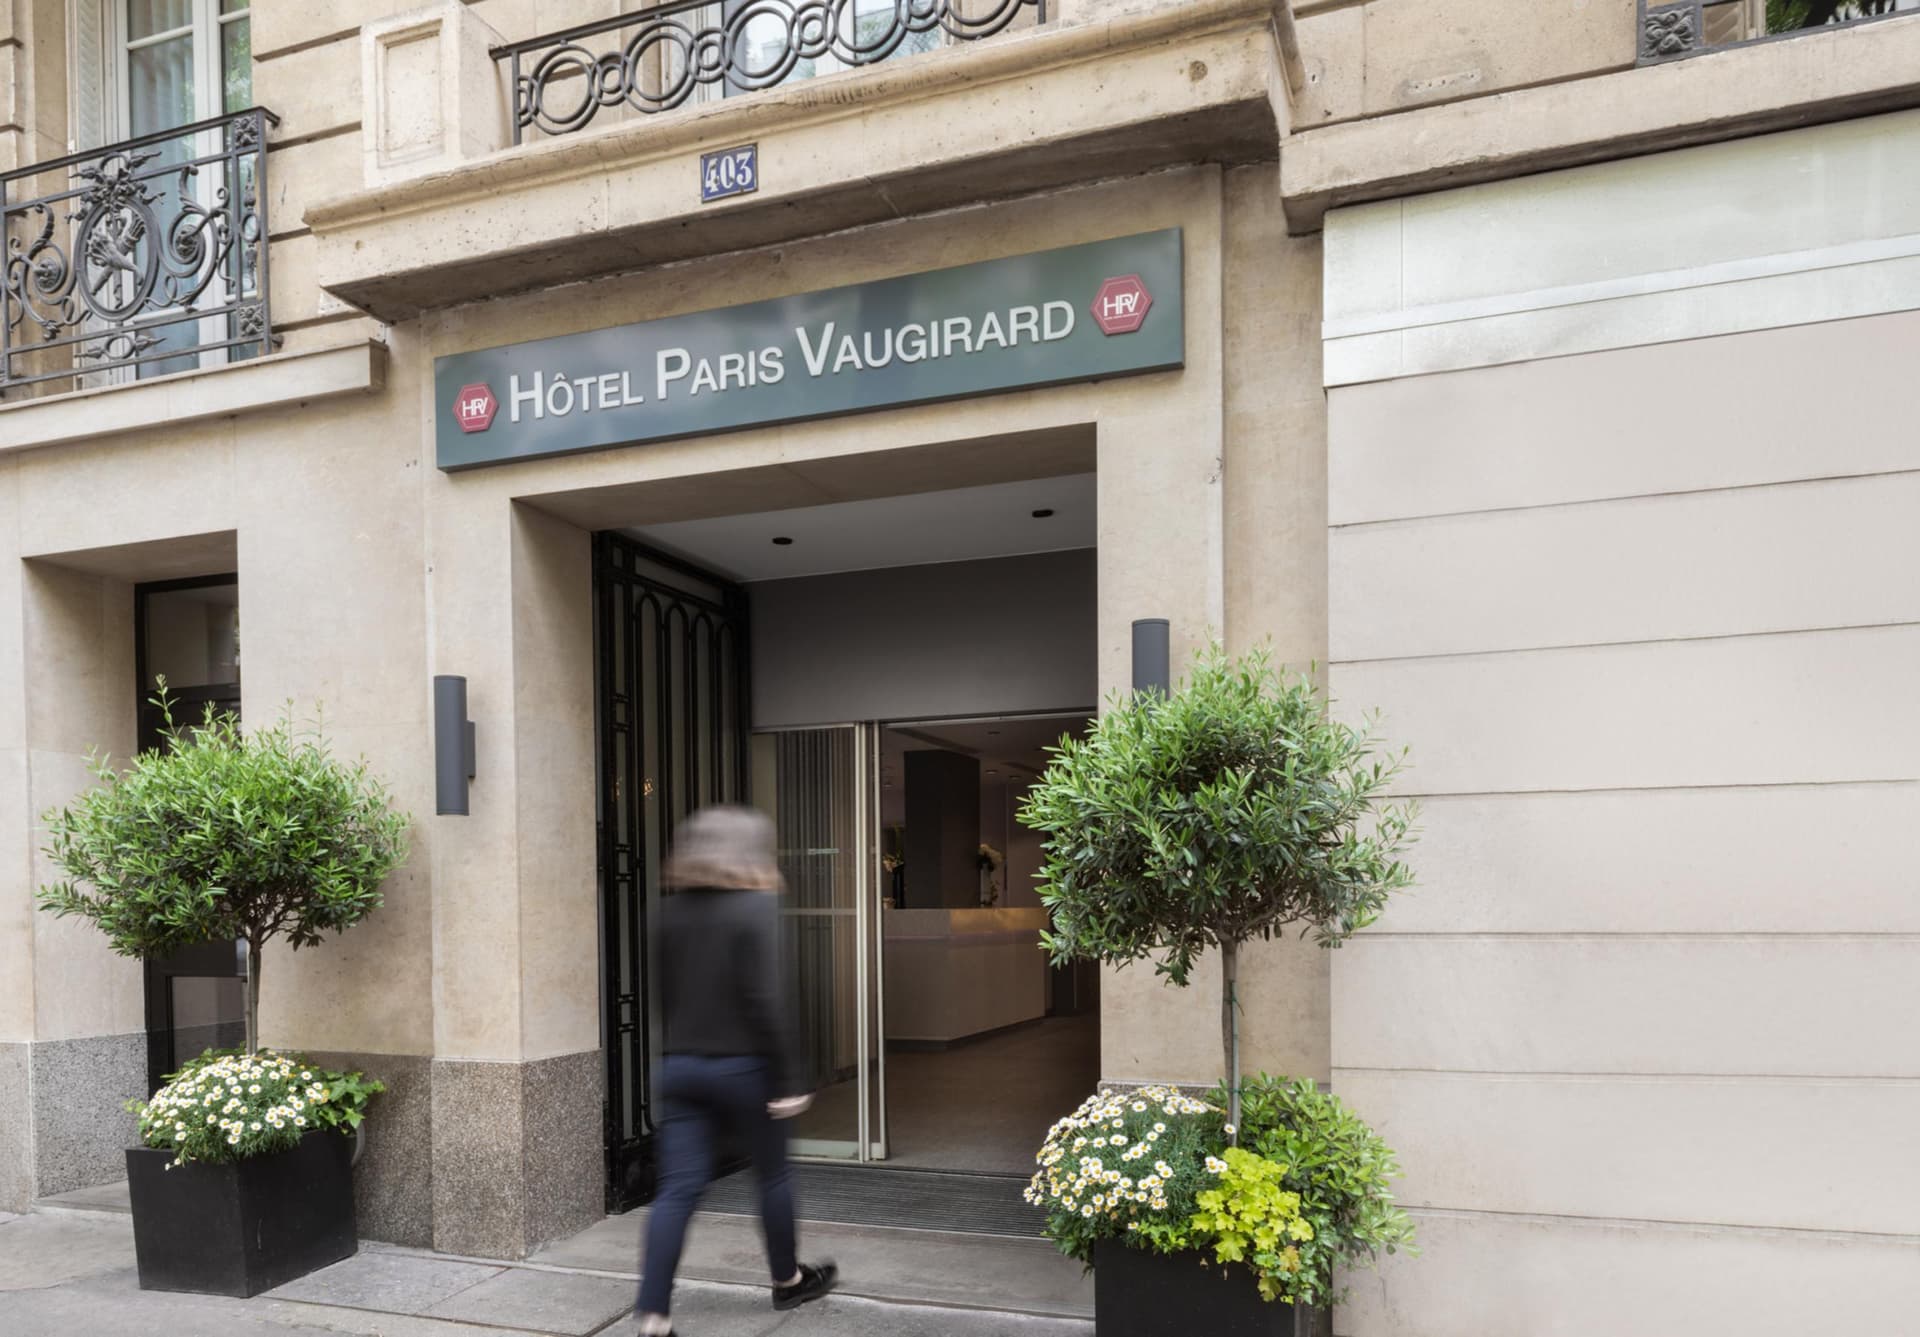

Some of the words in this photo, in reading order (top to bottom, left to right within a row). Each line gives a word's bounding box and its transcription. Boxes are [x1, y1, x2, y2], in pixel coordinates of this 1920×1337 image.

[705, 152, 752, 193] 403
[1103, 291, 1139, 317] HRV
[509, 370, 645, 423] HÔTEL
[656, 346, 785, 400] PARIS
[795, 300, 1075, 377] VAUGIRARD
[462, 397, 488, 417] HRV
